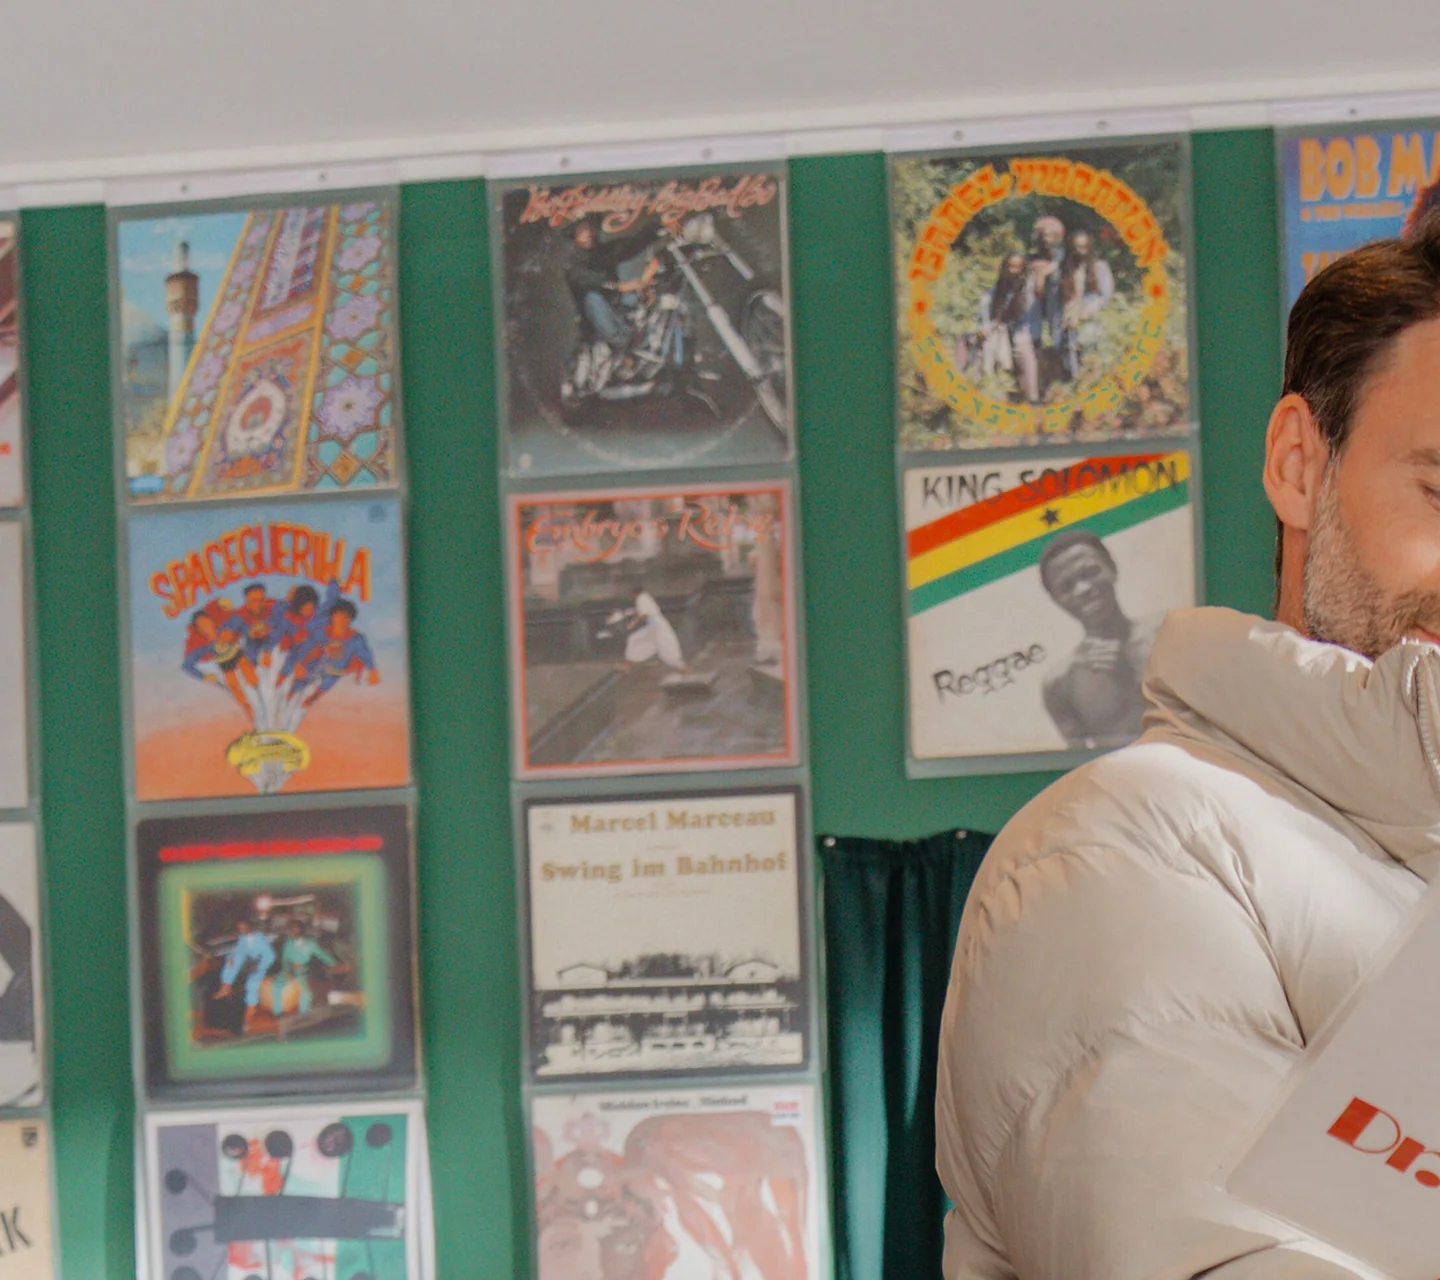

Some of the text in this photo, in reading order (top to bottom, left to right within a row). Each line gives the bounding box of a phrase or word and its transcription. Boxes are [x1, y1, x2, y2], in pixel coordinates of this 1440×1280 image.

[1299, 136, 1381, 202] BOB
[922, 460, 1178, 507] KING SOLOMON
[148, 521, 372, 619] SPACEGUERILLA
[932, 642, 1047, 703] Reggae
[570, 809, 776, 835] Marcel Marceau
[541, 851, 788, 883] Swing im Bahnhof
